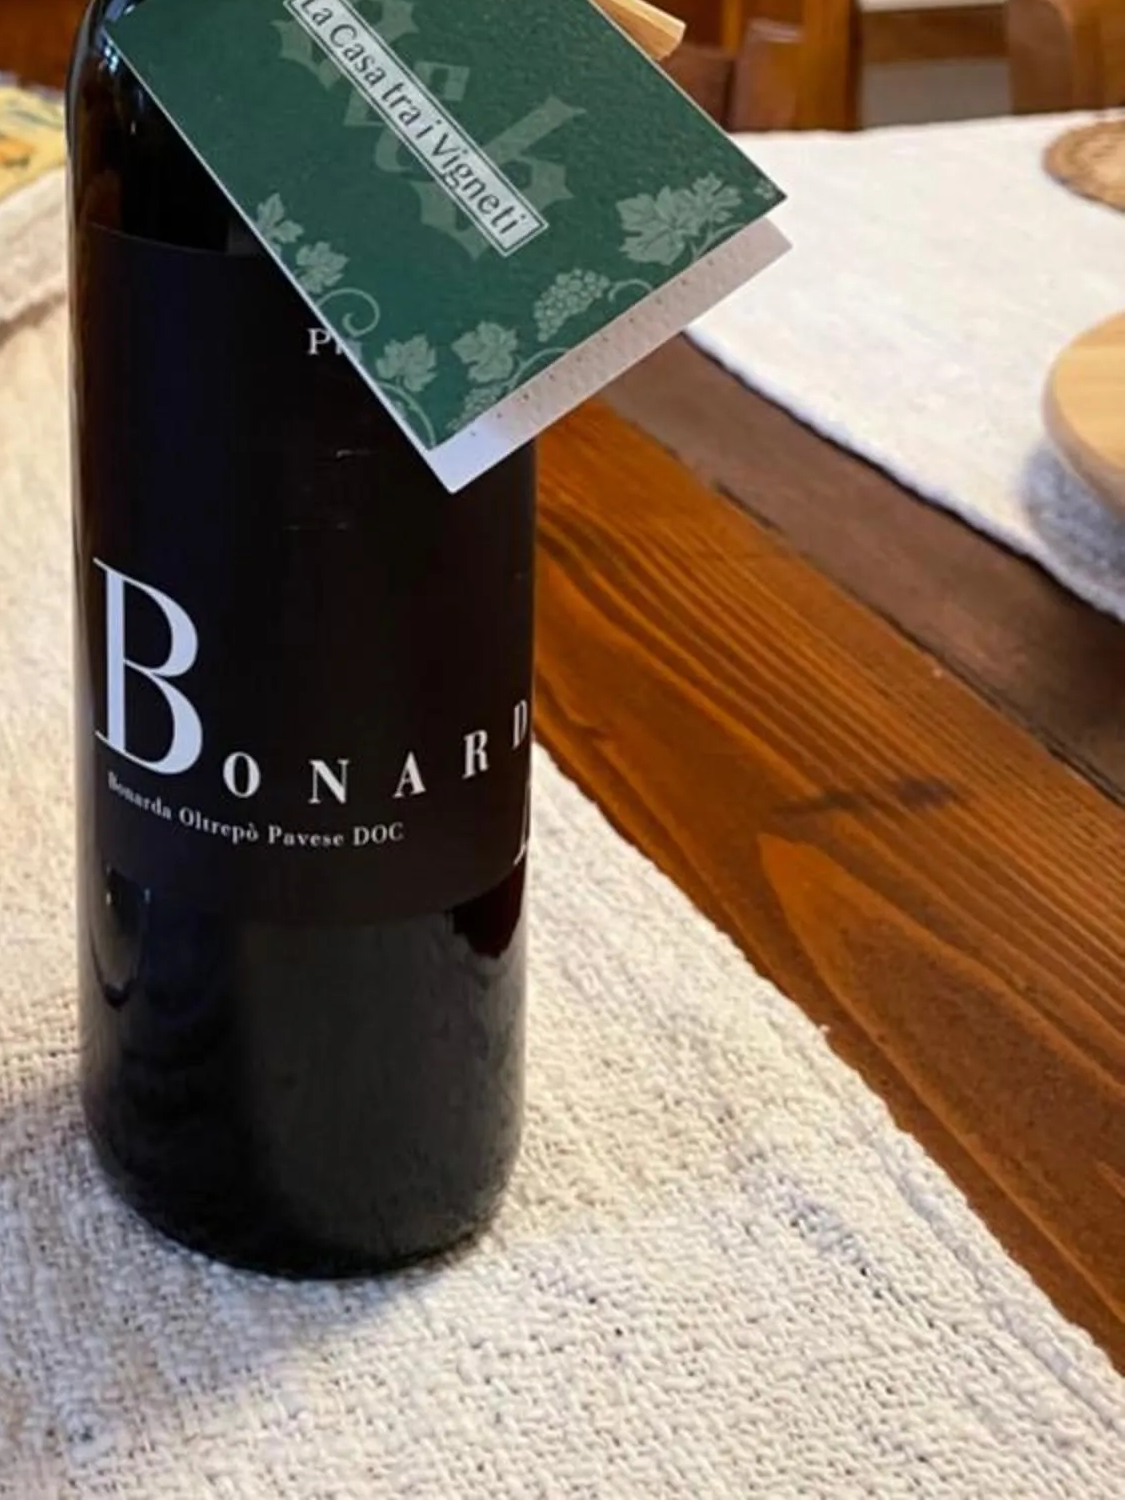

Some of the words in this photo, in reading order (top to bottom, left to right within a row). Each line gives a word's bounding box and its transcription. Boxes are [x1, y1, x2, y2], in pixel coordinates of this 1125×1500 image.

[329, 23, 387, 88] Casa
[380, 81, 423, 128] tra
[431, 132, 527, 235] Vigneti
[92, 556, 530, 864] BONARD
[107, 770, 172, 820] Bonarda
[178, 806, 259, 845] Oltrepò
[268, 825, 345, 848] Pavese
[353, 821, 405, 847] DOC
